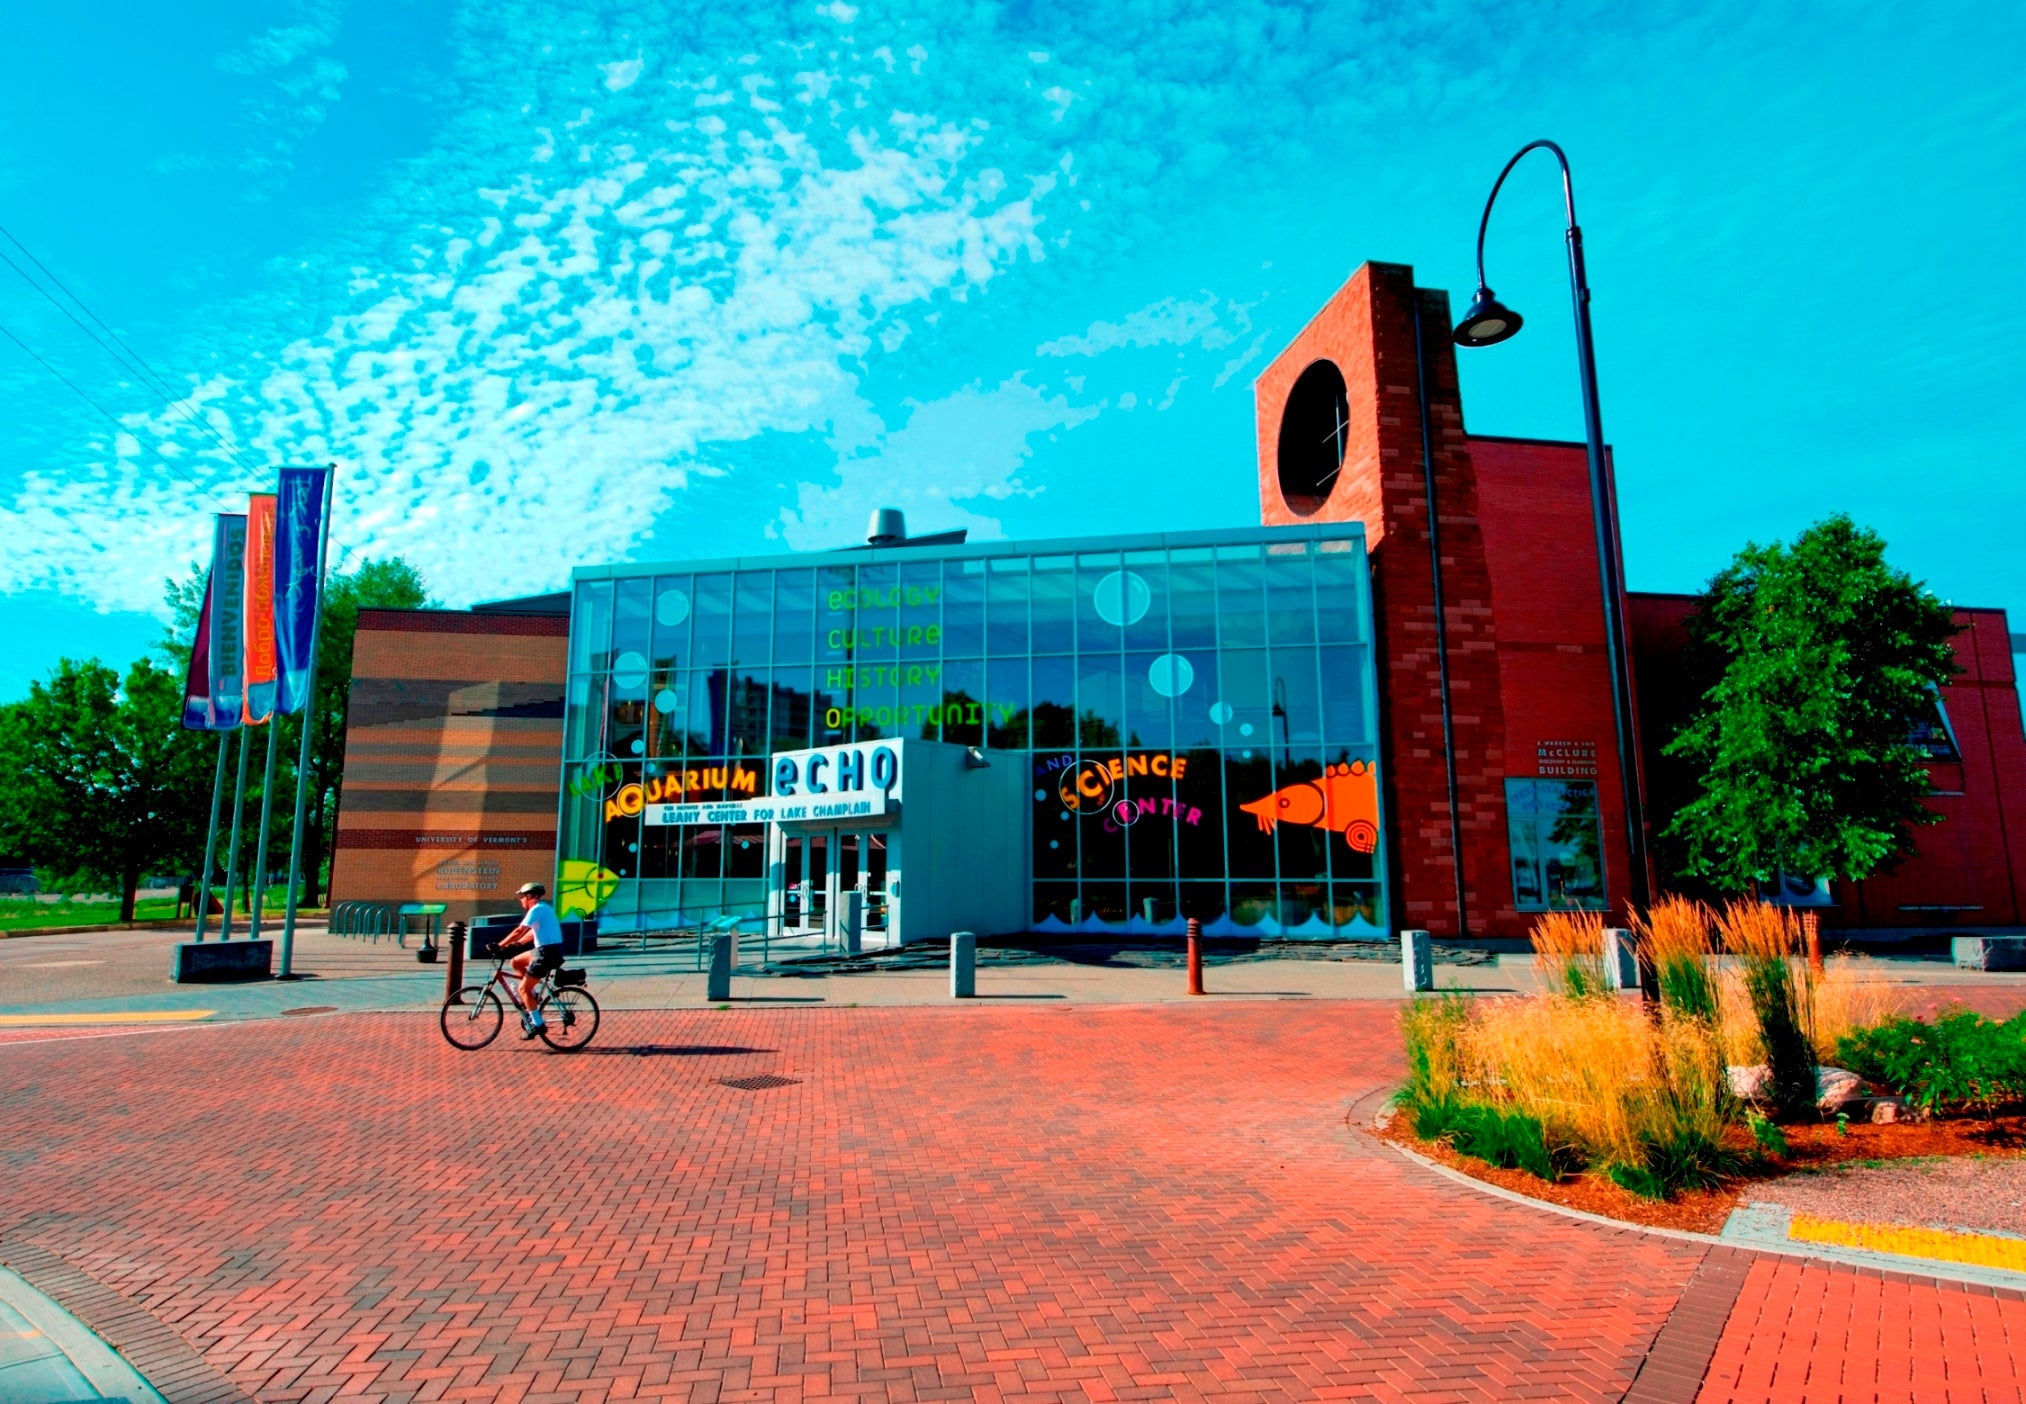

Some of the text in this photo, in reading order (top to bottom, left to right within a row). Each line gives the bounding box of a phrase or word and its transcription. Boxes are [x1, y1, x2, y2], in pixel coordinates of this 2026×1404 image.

[221, 527, 245, 677] BIENVENIDOS
[826, 664, 941, 689] HISTORY
[825, 702, 1015, 729] OPPORTUNITY
[1060, 755, 1188, 810] SCIENCE
[1539, 766, 1598, 775] BUILDING
[605, 767, 757, 823] AQUARIUM
[662, 800, 872, 824] LEAHY CENTER FOR LAKE CHAMPLAIN
[1103, 797, 1203, 833] CENTER
[483, 836, 528, 844] VERMONT'S
